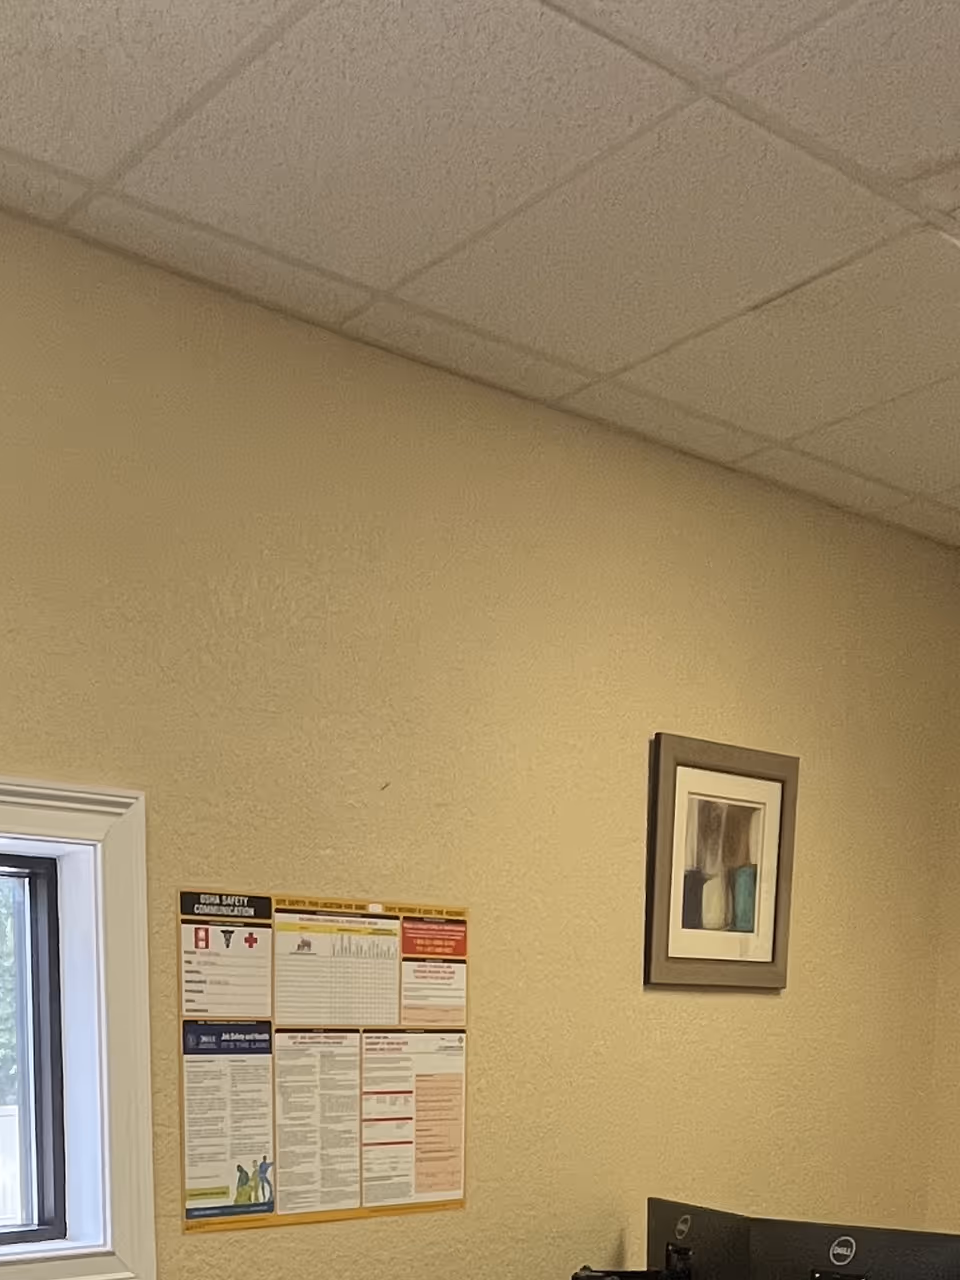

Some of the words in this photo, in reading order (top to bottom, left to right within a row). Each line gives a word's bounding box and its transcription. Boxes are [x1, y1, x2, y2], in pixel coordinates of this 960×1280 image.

[200, 894, 220, 904] OSHA
[222, 895, 248, 906] SAFETY
[194, 904, 254, 916] COMMUNICATION
